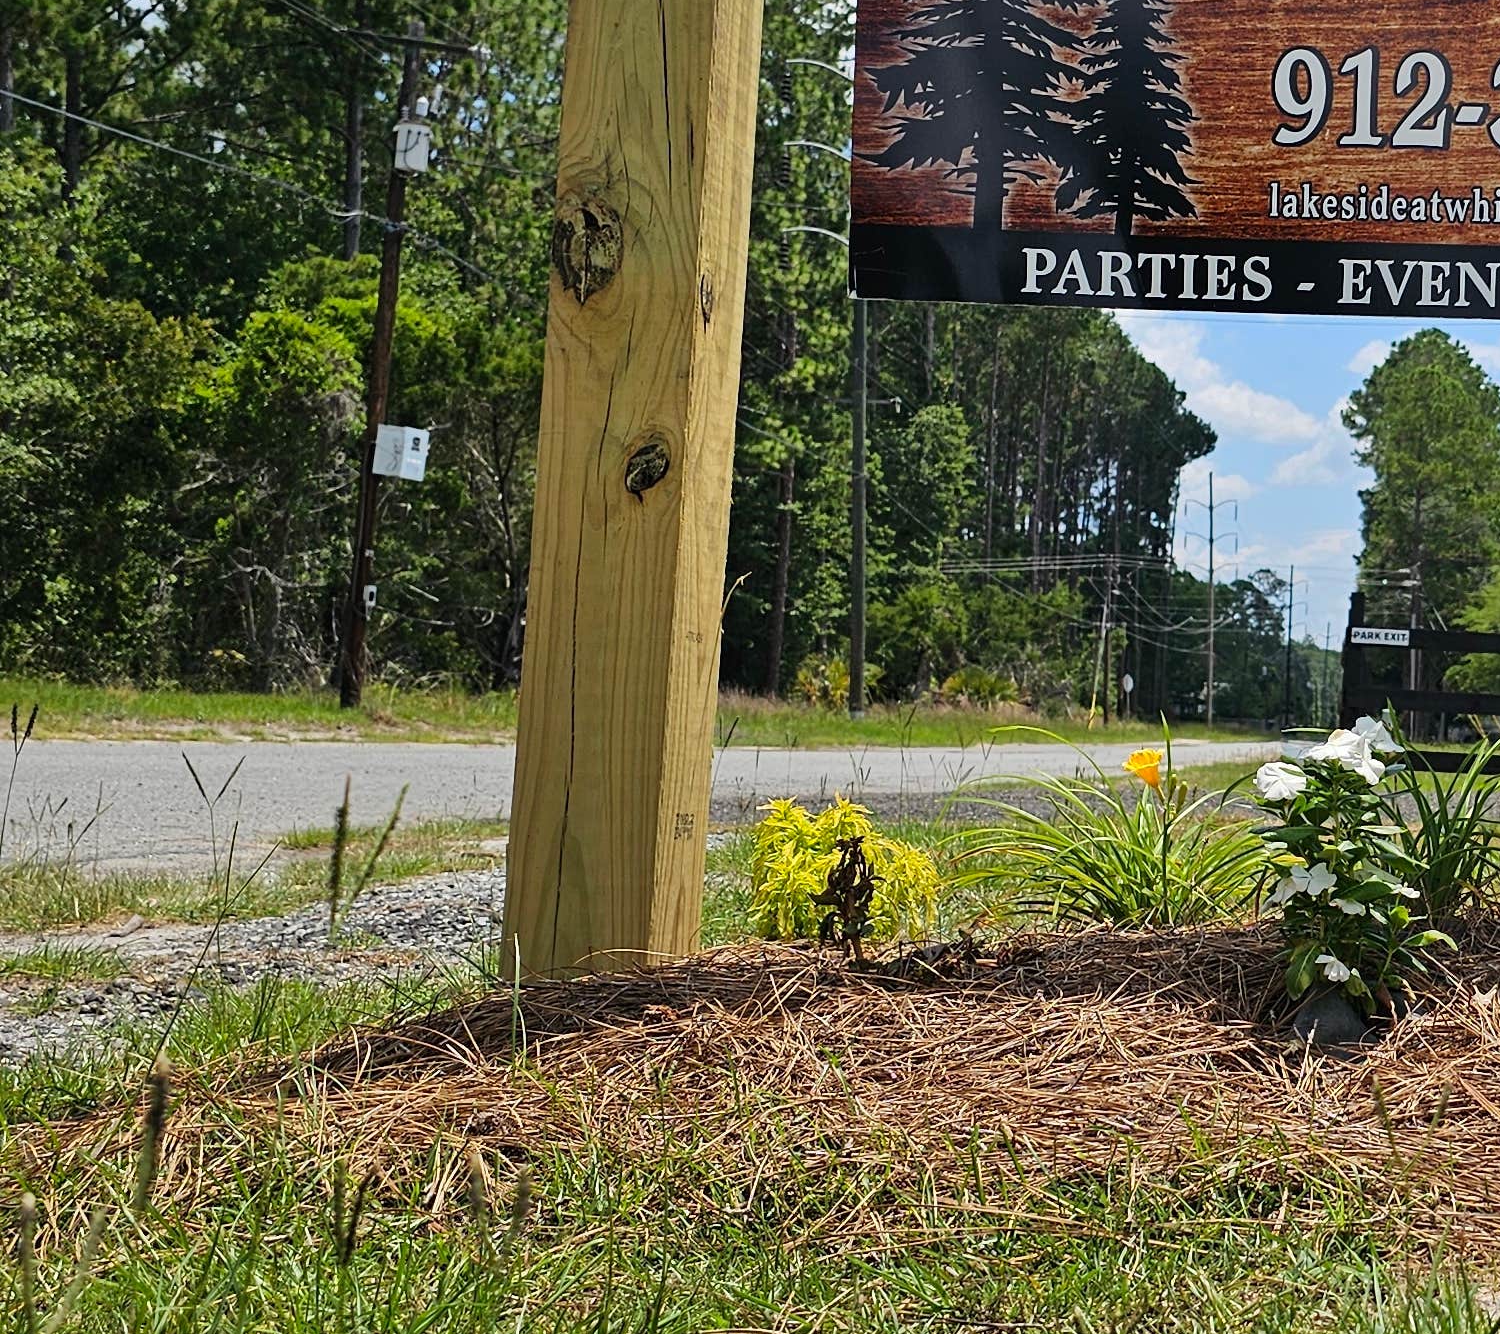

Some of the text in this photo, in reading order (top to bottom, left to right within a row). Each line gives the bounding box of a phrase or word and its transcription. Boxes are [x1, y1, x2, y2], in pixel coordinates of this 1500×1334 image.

[1019, 246, 1274, 303] PARTIES
[1352, 630, 1407, 642] PARK EXIT
